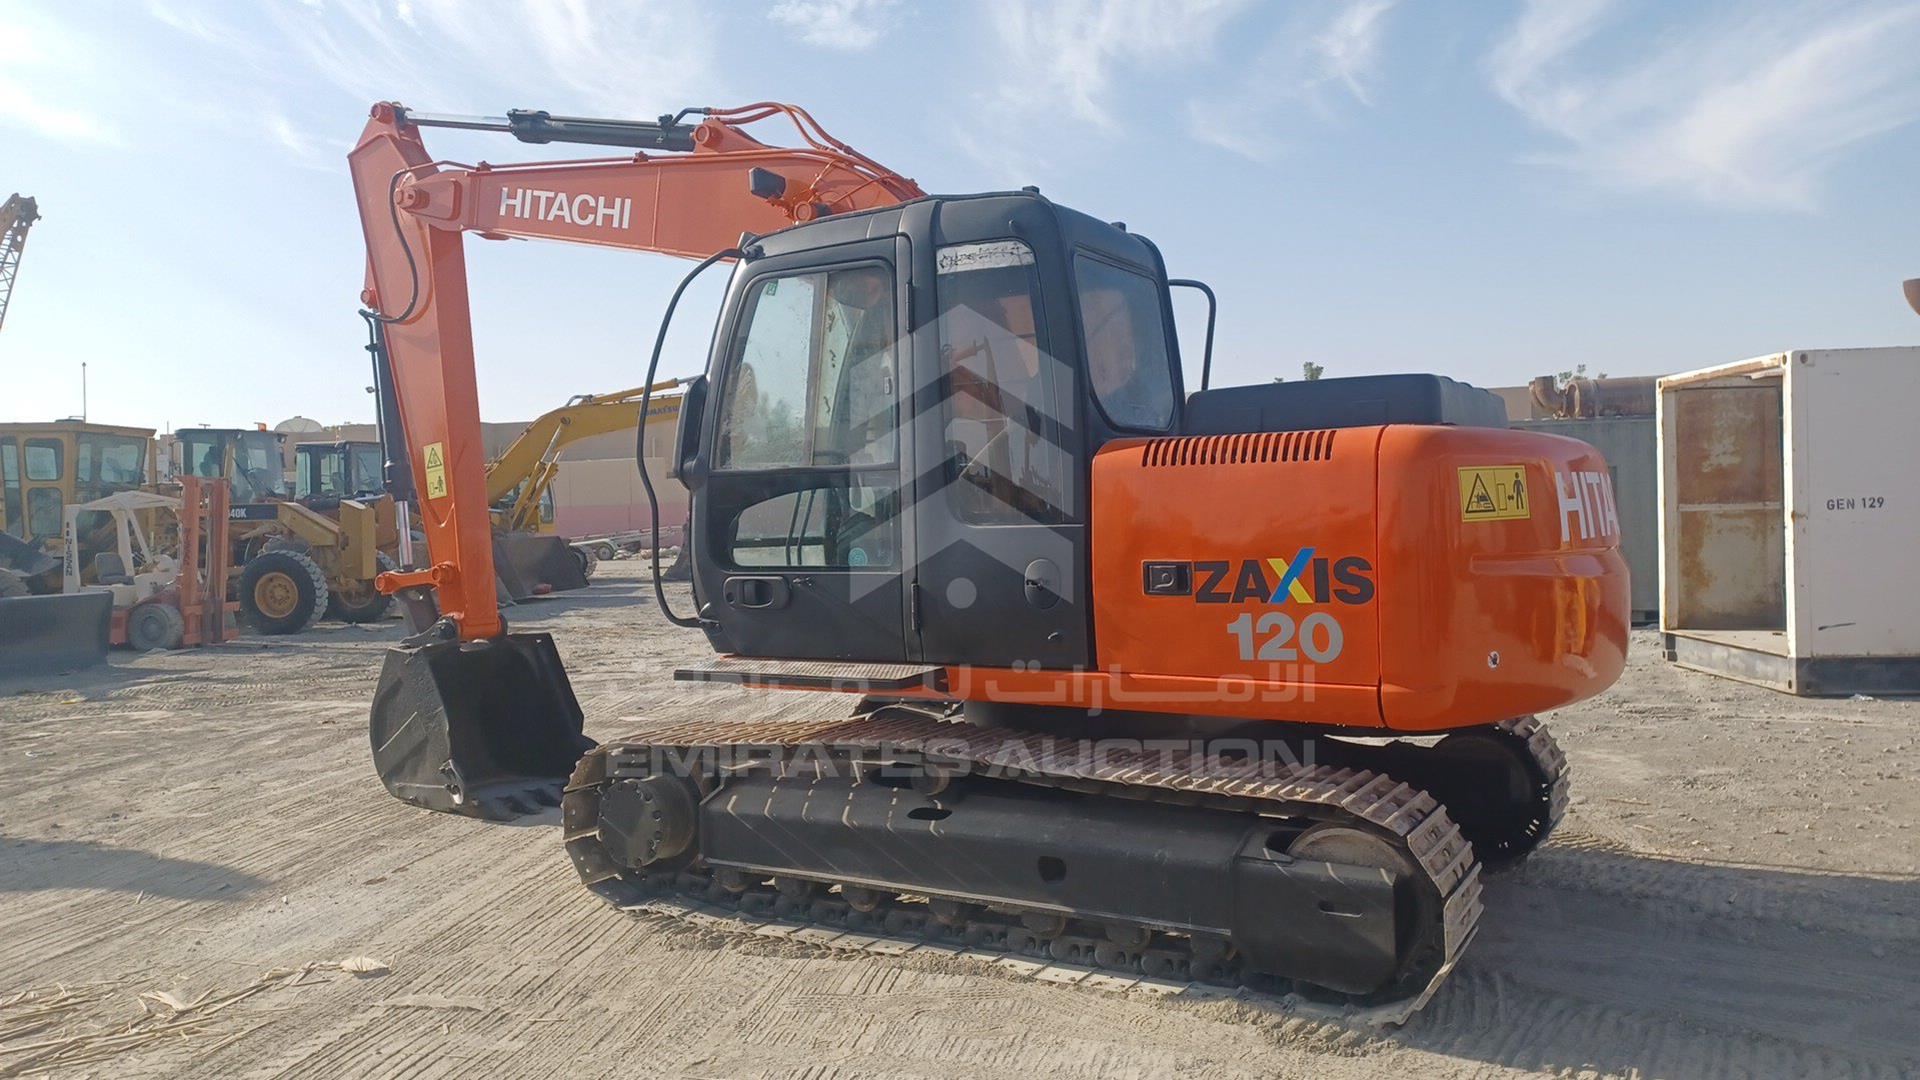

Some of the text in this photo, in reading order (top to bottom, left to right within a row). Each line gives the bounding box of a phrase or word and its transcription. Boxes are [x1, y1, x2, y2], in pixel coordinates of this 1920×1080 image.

[499, 187, 632, 229] HITACHI
[229, 507, 247, 519] 40K
[1826, 496, 1885, 511] GEN 129
[1194, 547, 1375, 605] ZAXIS
[1227, 611, 1344, 663] 120
